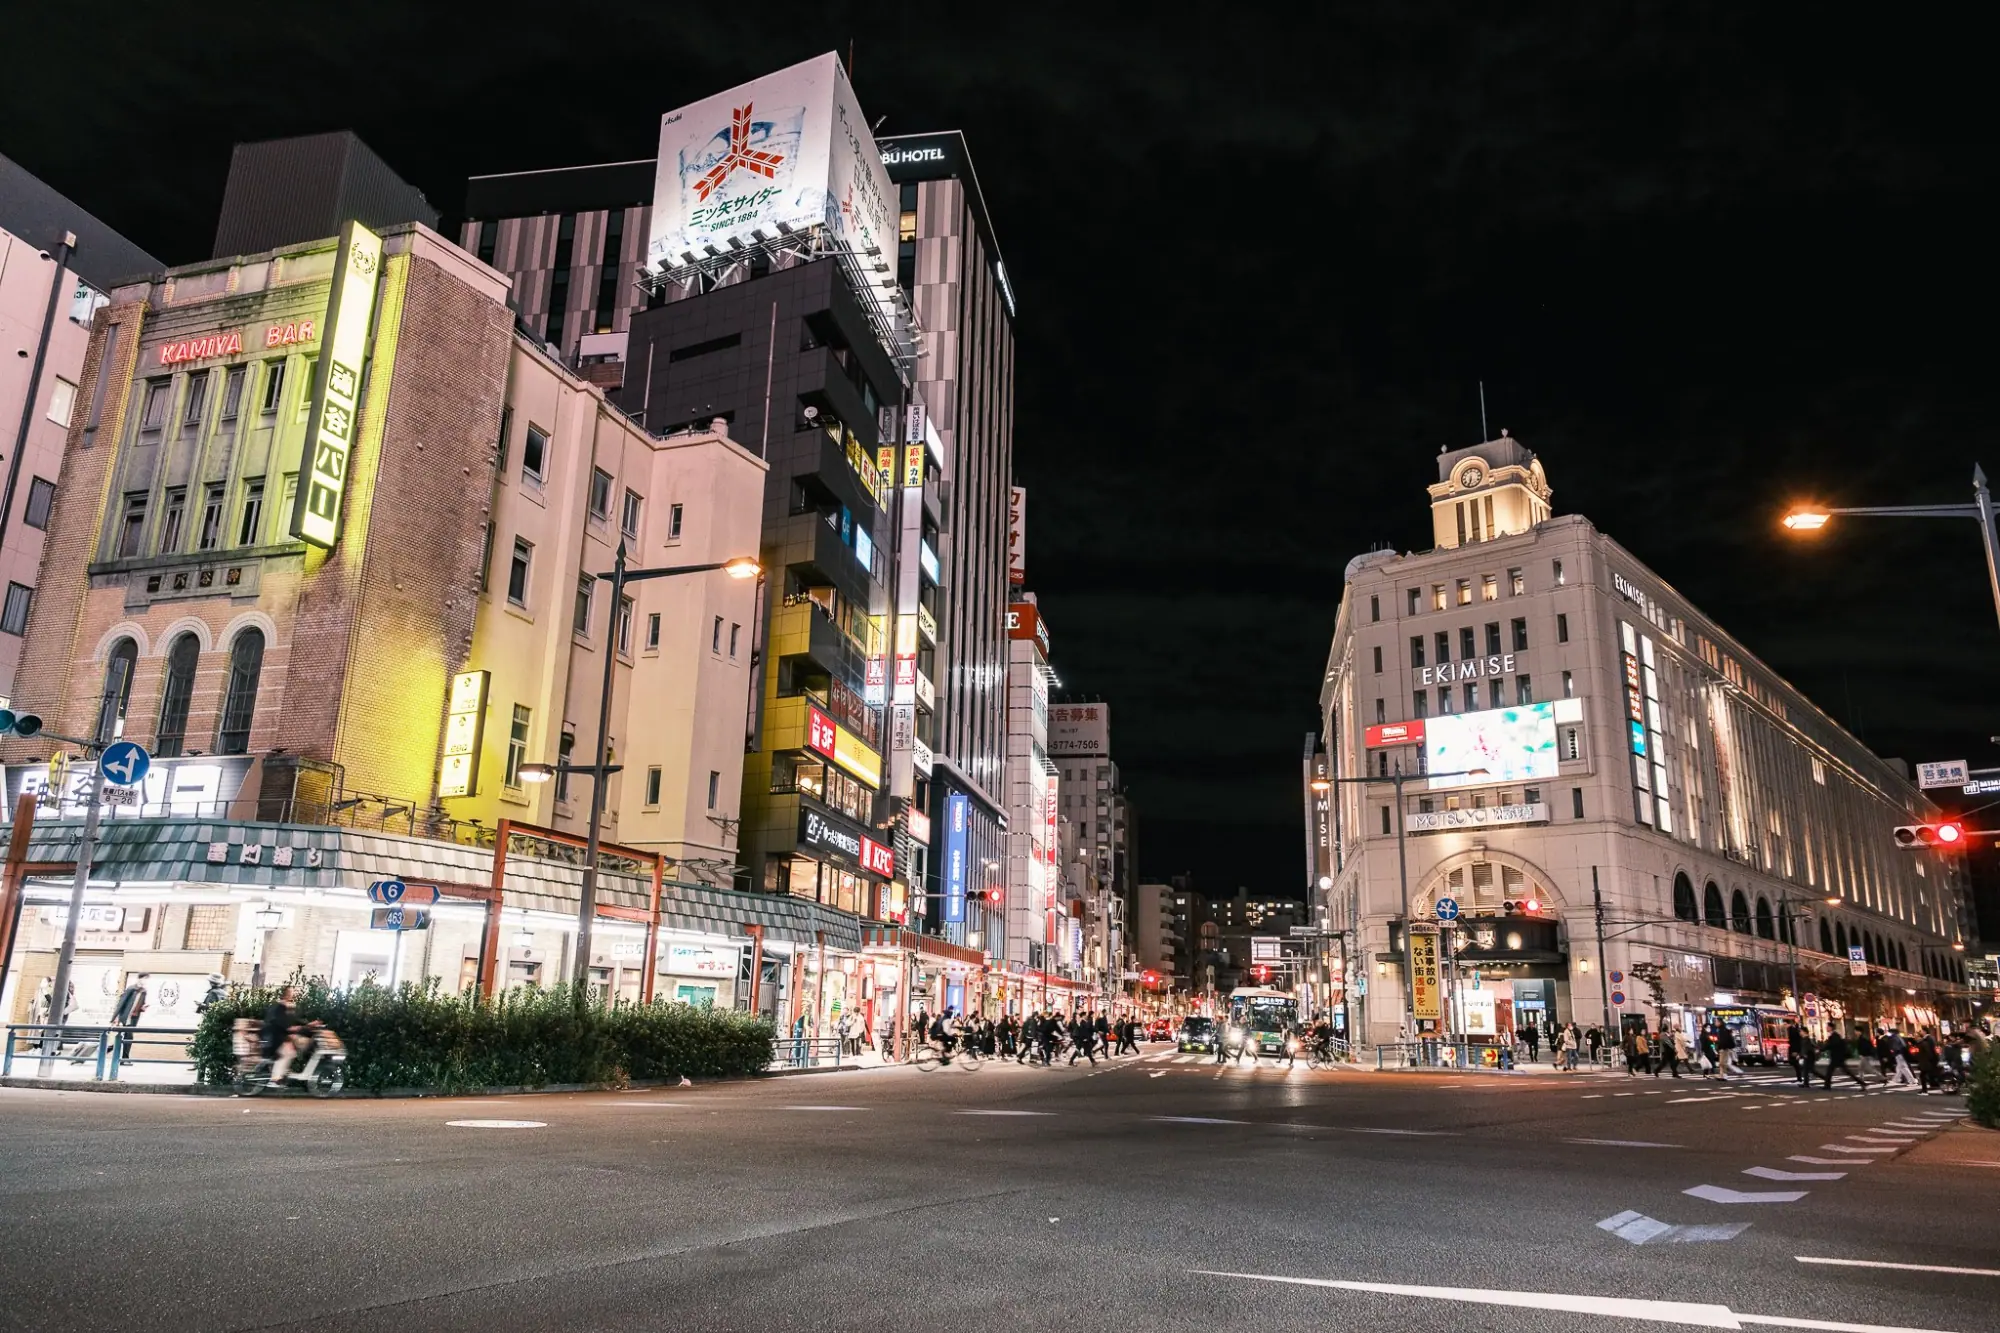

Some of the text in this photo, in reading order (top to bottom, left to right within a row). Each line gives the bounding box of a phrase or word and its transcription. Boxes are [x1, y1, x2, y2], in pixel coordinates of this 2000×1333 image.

[664, 113, 683, 126] Asahi
[901, 148, 945, 162] HOTEL
[689, 186, 783, 228] 三ツ矢サイダー
[710, 209, 760, 233] SINCE 1884
[160, 319, 315, 366] KAMIYA BAR
[316, 363, 355, 515] 神谷バー
[1614, 573, 1645, 608] EKIMISE
[1422, 654, 1516, 686] EKIMISE
[821, 723, 834, 750] 3F
[1924, 777, 1966, 787] Azumabashi
[1317, 764, 1329, 847] EIMISE
[808, 812, 819, 835] 2F
[873, 846, 892, 873] KFC
[388, 884, 399, 898] 6
[388, 911, 403, 925] 463
[1424, 937, 1436, 986] 交通事故の
[1413, 946, 1426, 1007] ない街浅草を
